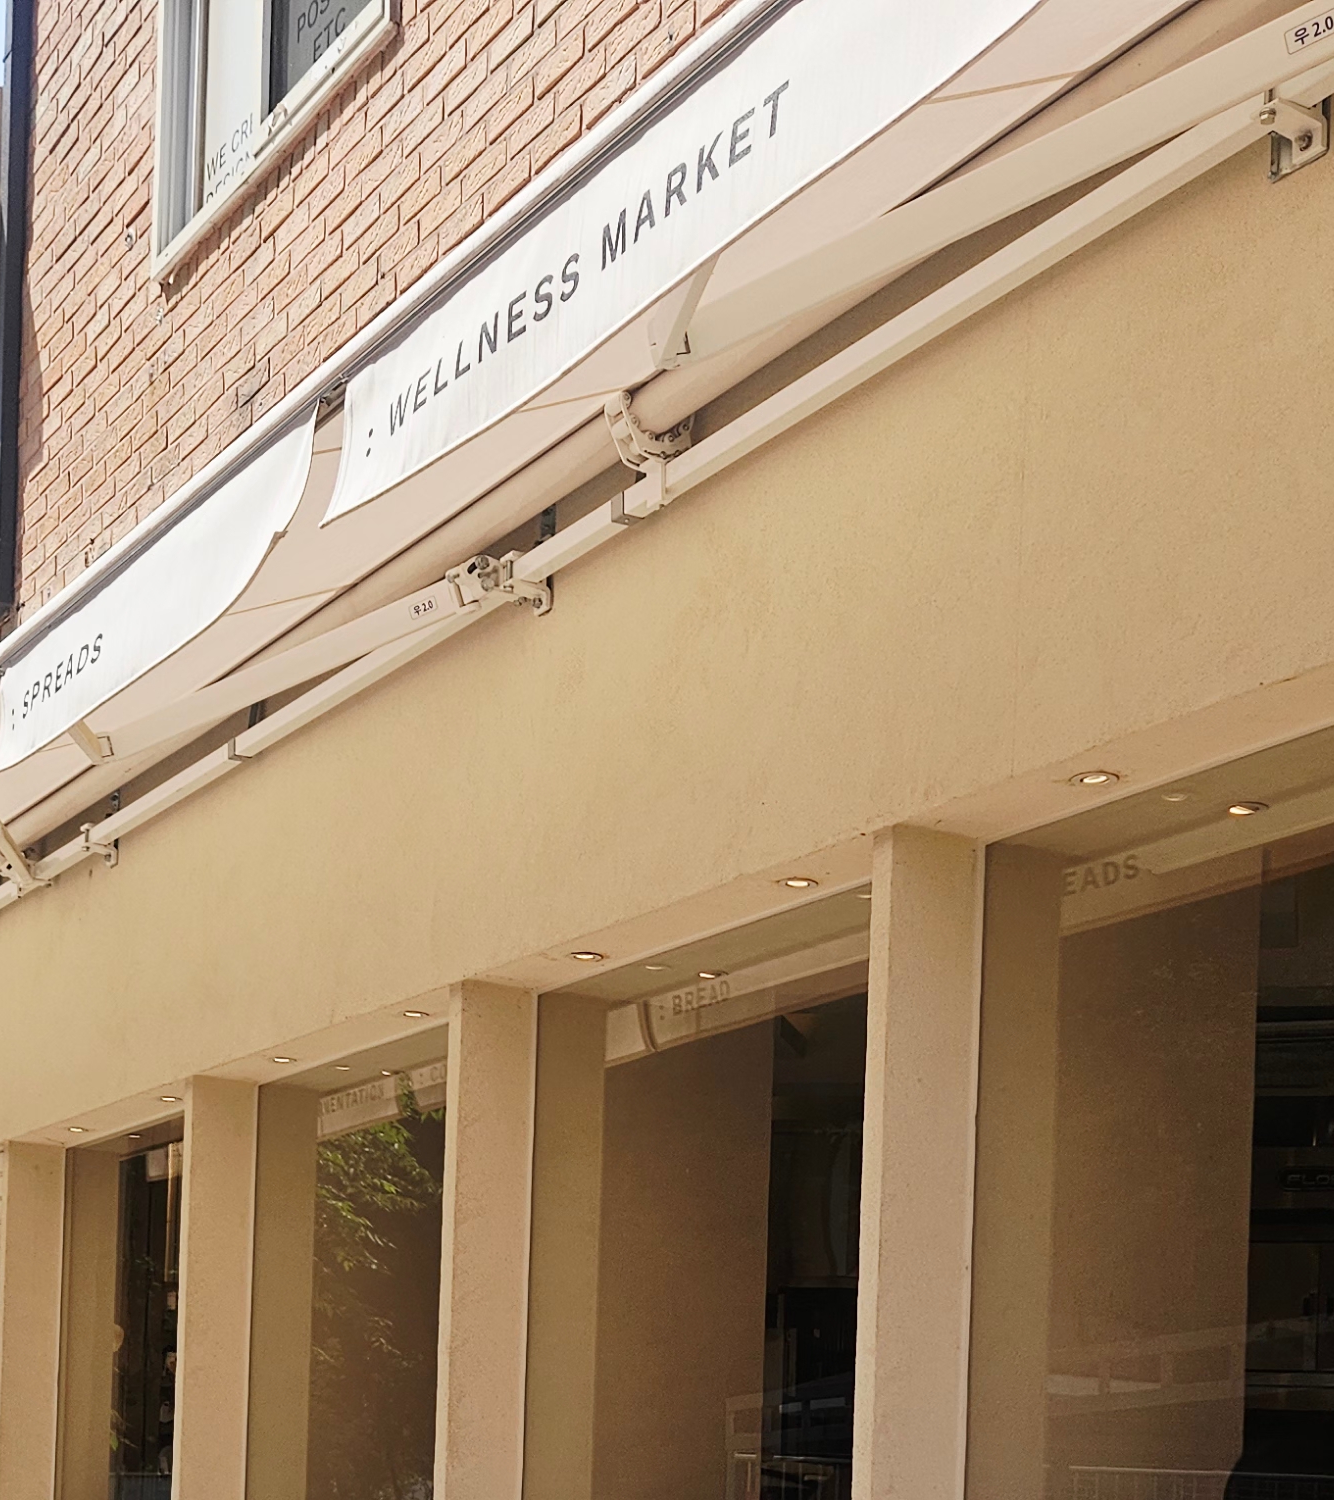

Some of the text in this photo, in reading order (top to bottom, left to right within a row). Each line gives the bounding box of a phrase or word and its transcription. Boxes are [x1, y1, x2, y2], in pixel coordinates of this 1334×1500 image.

[1294, 15, 1334, 45] 우 2.0
[207, 112, 253, 181] WE CR
[388, 252, 581, 437] WELLNESS
[600, 79, 790, 271] MARKET
[22, 633, 103, 719] SPREADS
